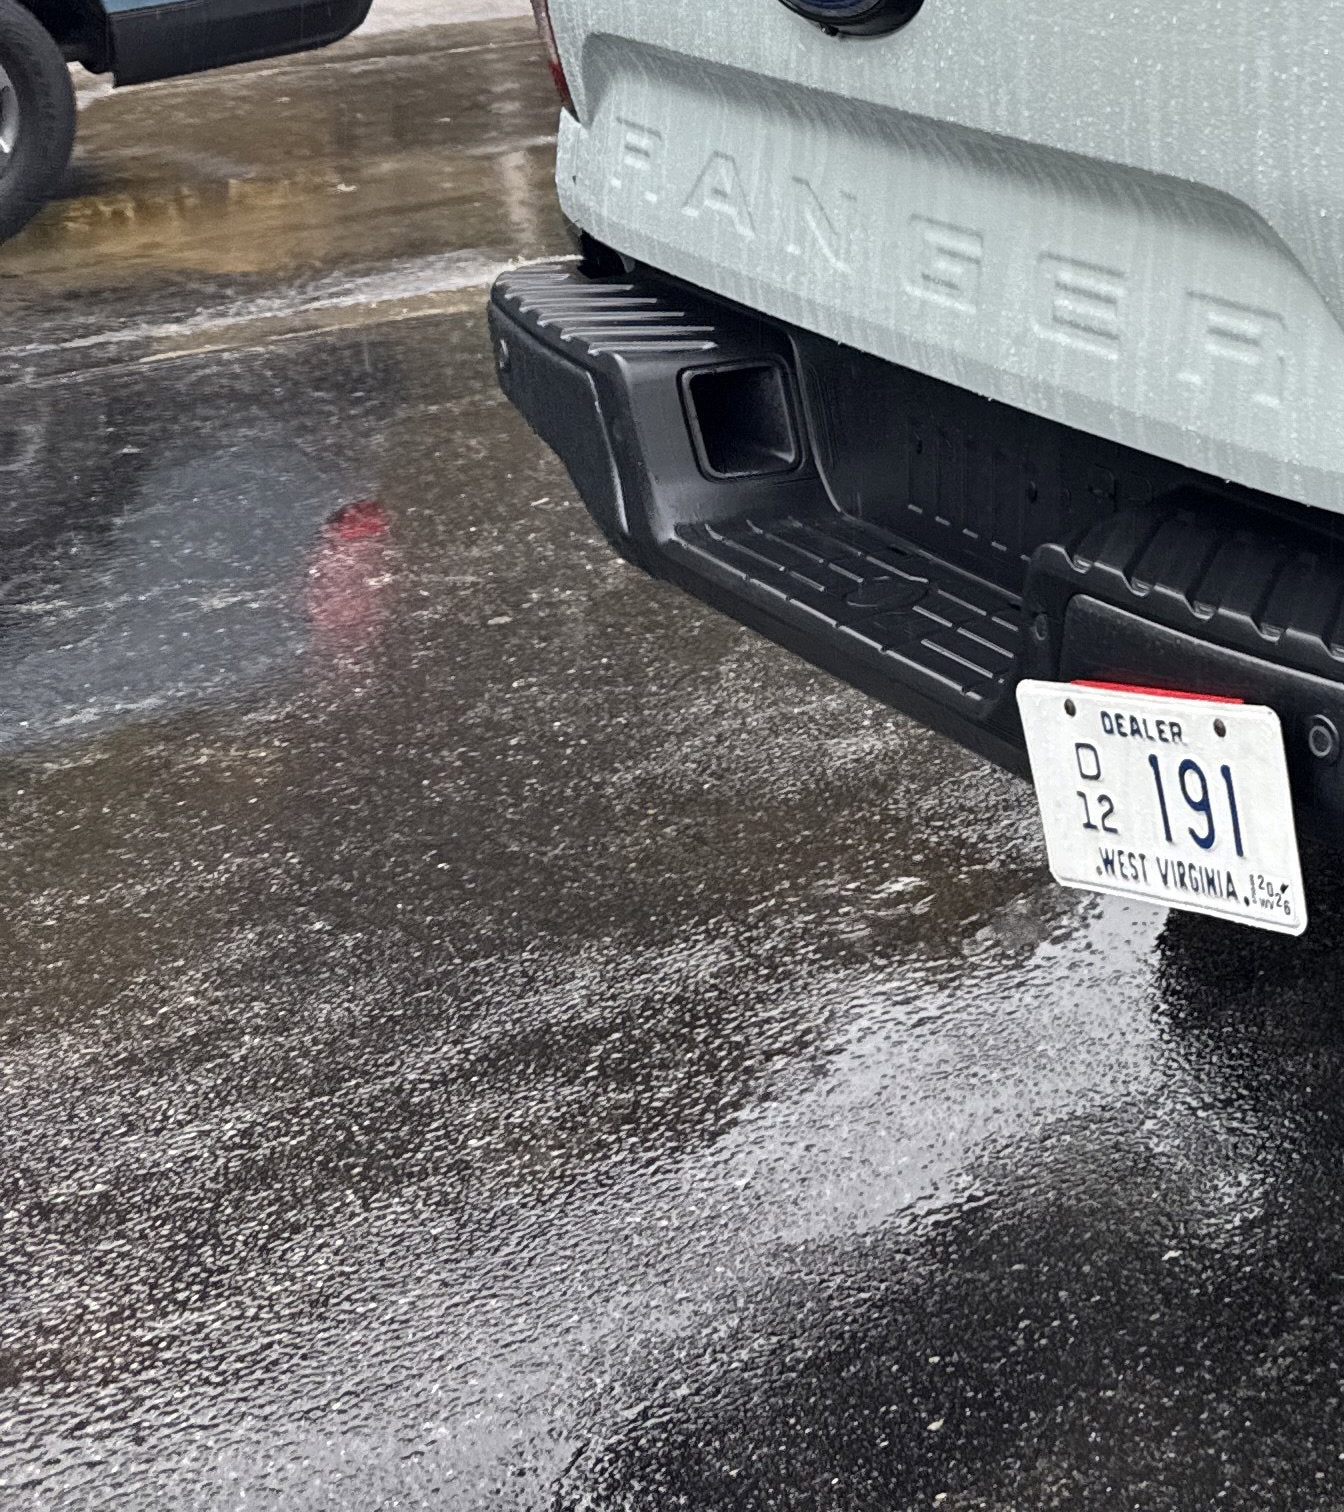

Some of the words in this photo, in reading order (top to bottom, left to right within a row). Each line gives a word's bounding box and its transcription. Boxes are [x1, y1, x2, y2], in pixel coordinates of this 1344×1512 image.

[610, 116, 1285, 408] RANGER
[1100, 711, 1184, 743] DEALER
[1076, 790, 1118, 833] 12
[1148, 754, 1244, 857] 191
[1099, 848, 1148, 883] WEST
[1155, 857, 1239, 901] VIRGINIA
